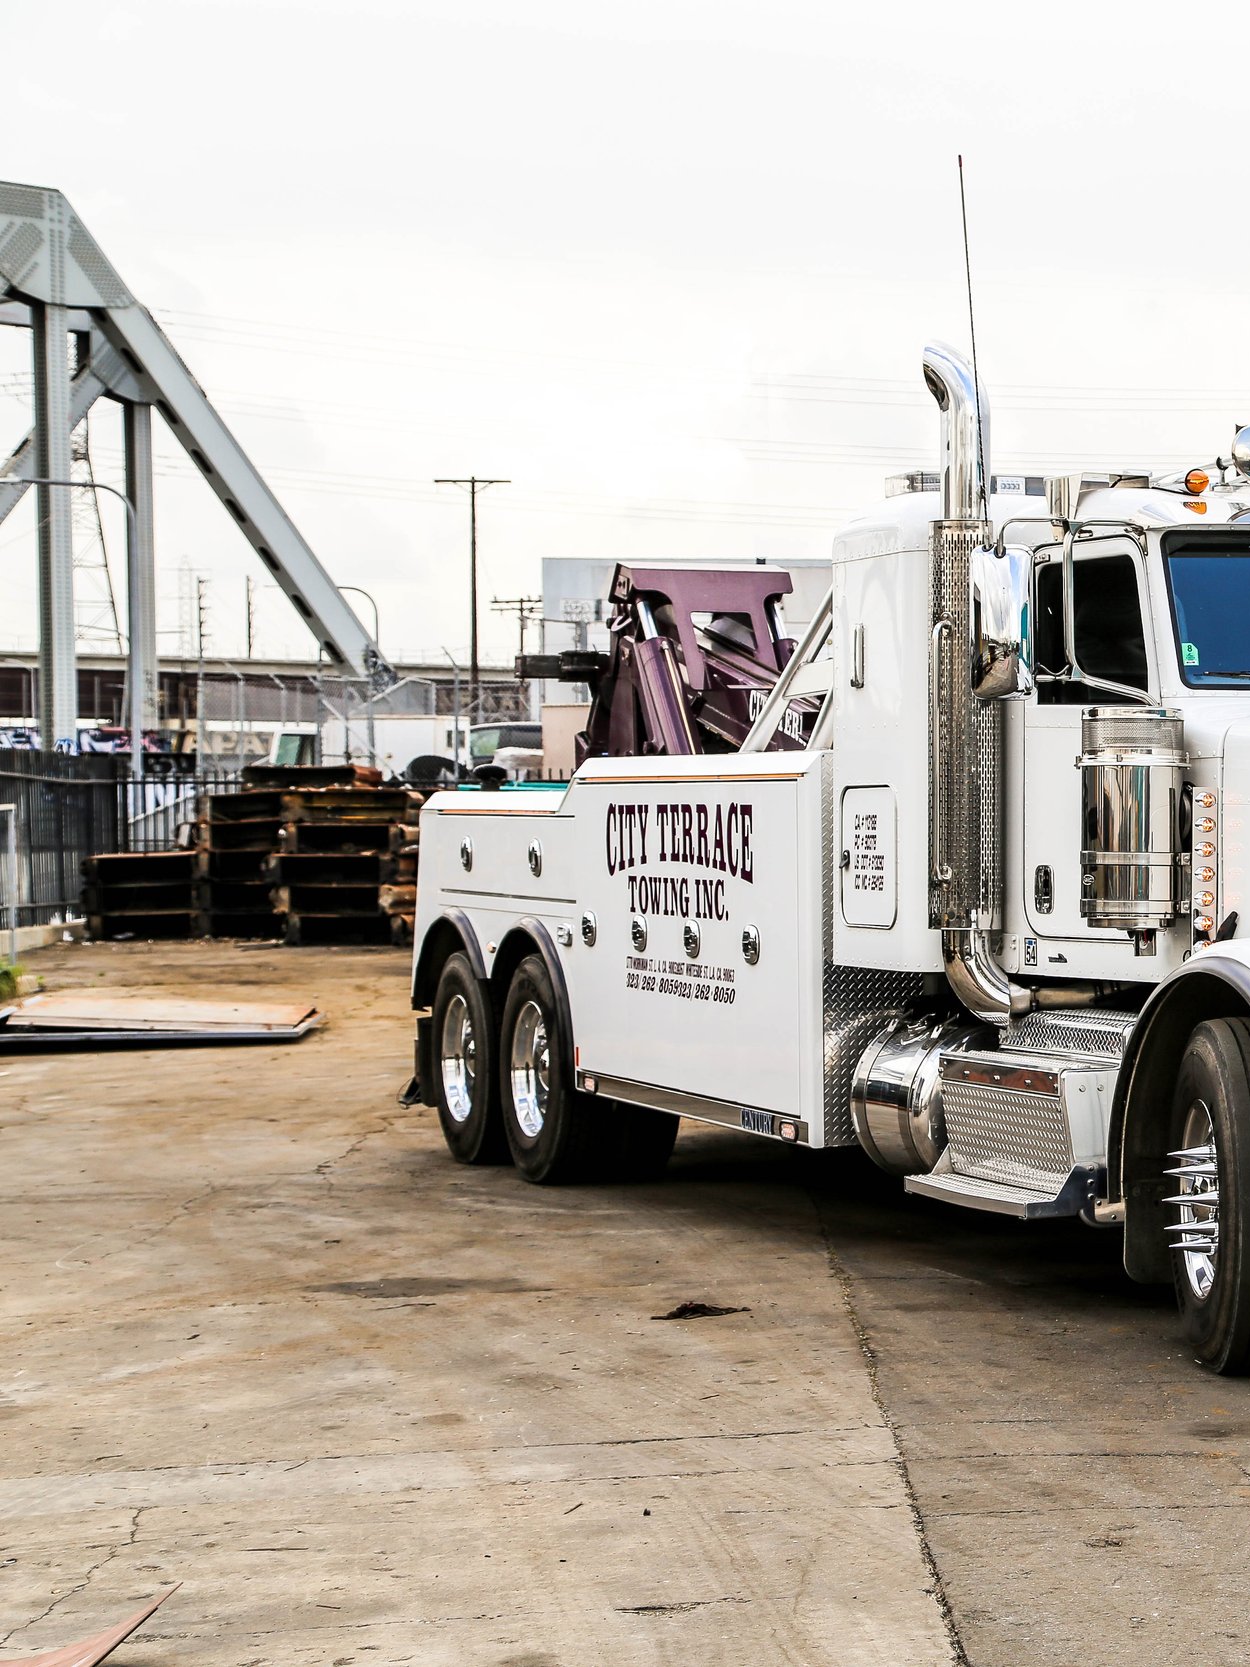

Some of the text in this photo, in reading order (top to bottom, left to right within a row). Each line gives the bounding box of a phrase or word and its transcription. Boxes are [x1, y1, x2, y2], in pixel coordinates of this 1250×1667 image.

[606, 802, 754, 884] CITY TERRACE
[628, 875, 728, 921] TOWING INC.
